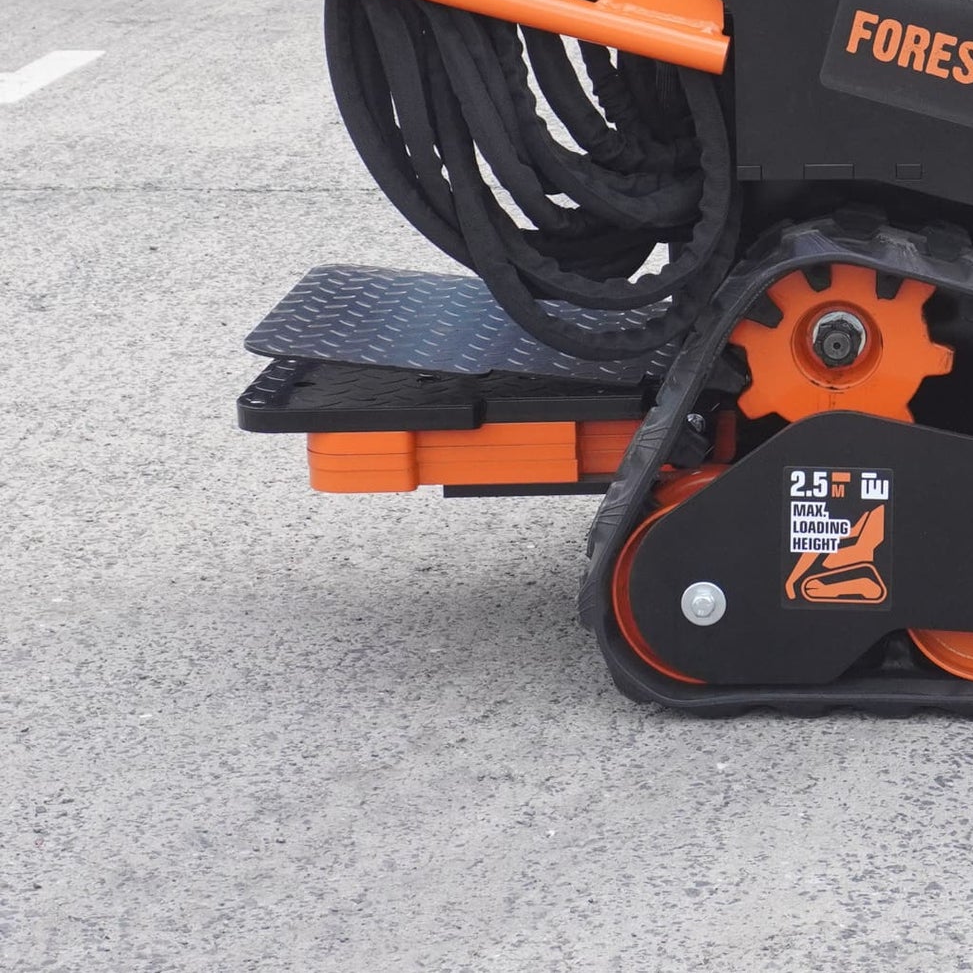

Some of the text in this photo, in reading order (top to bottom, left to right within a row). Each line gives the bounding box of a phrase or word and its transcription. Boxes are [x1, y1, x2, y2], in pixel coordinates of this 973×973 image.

[790, 470, 828, 497] 2.5
[793, 504, 827, 518] MAX.
[793, 520, 849, 535] LOADING
[793, 537, 838, 551] HEIGHT
